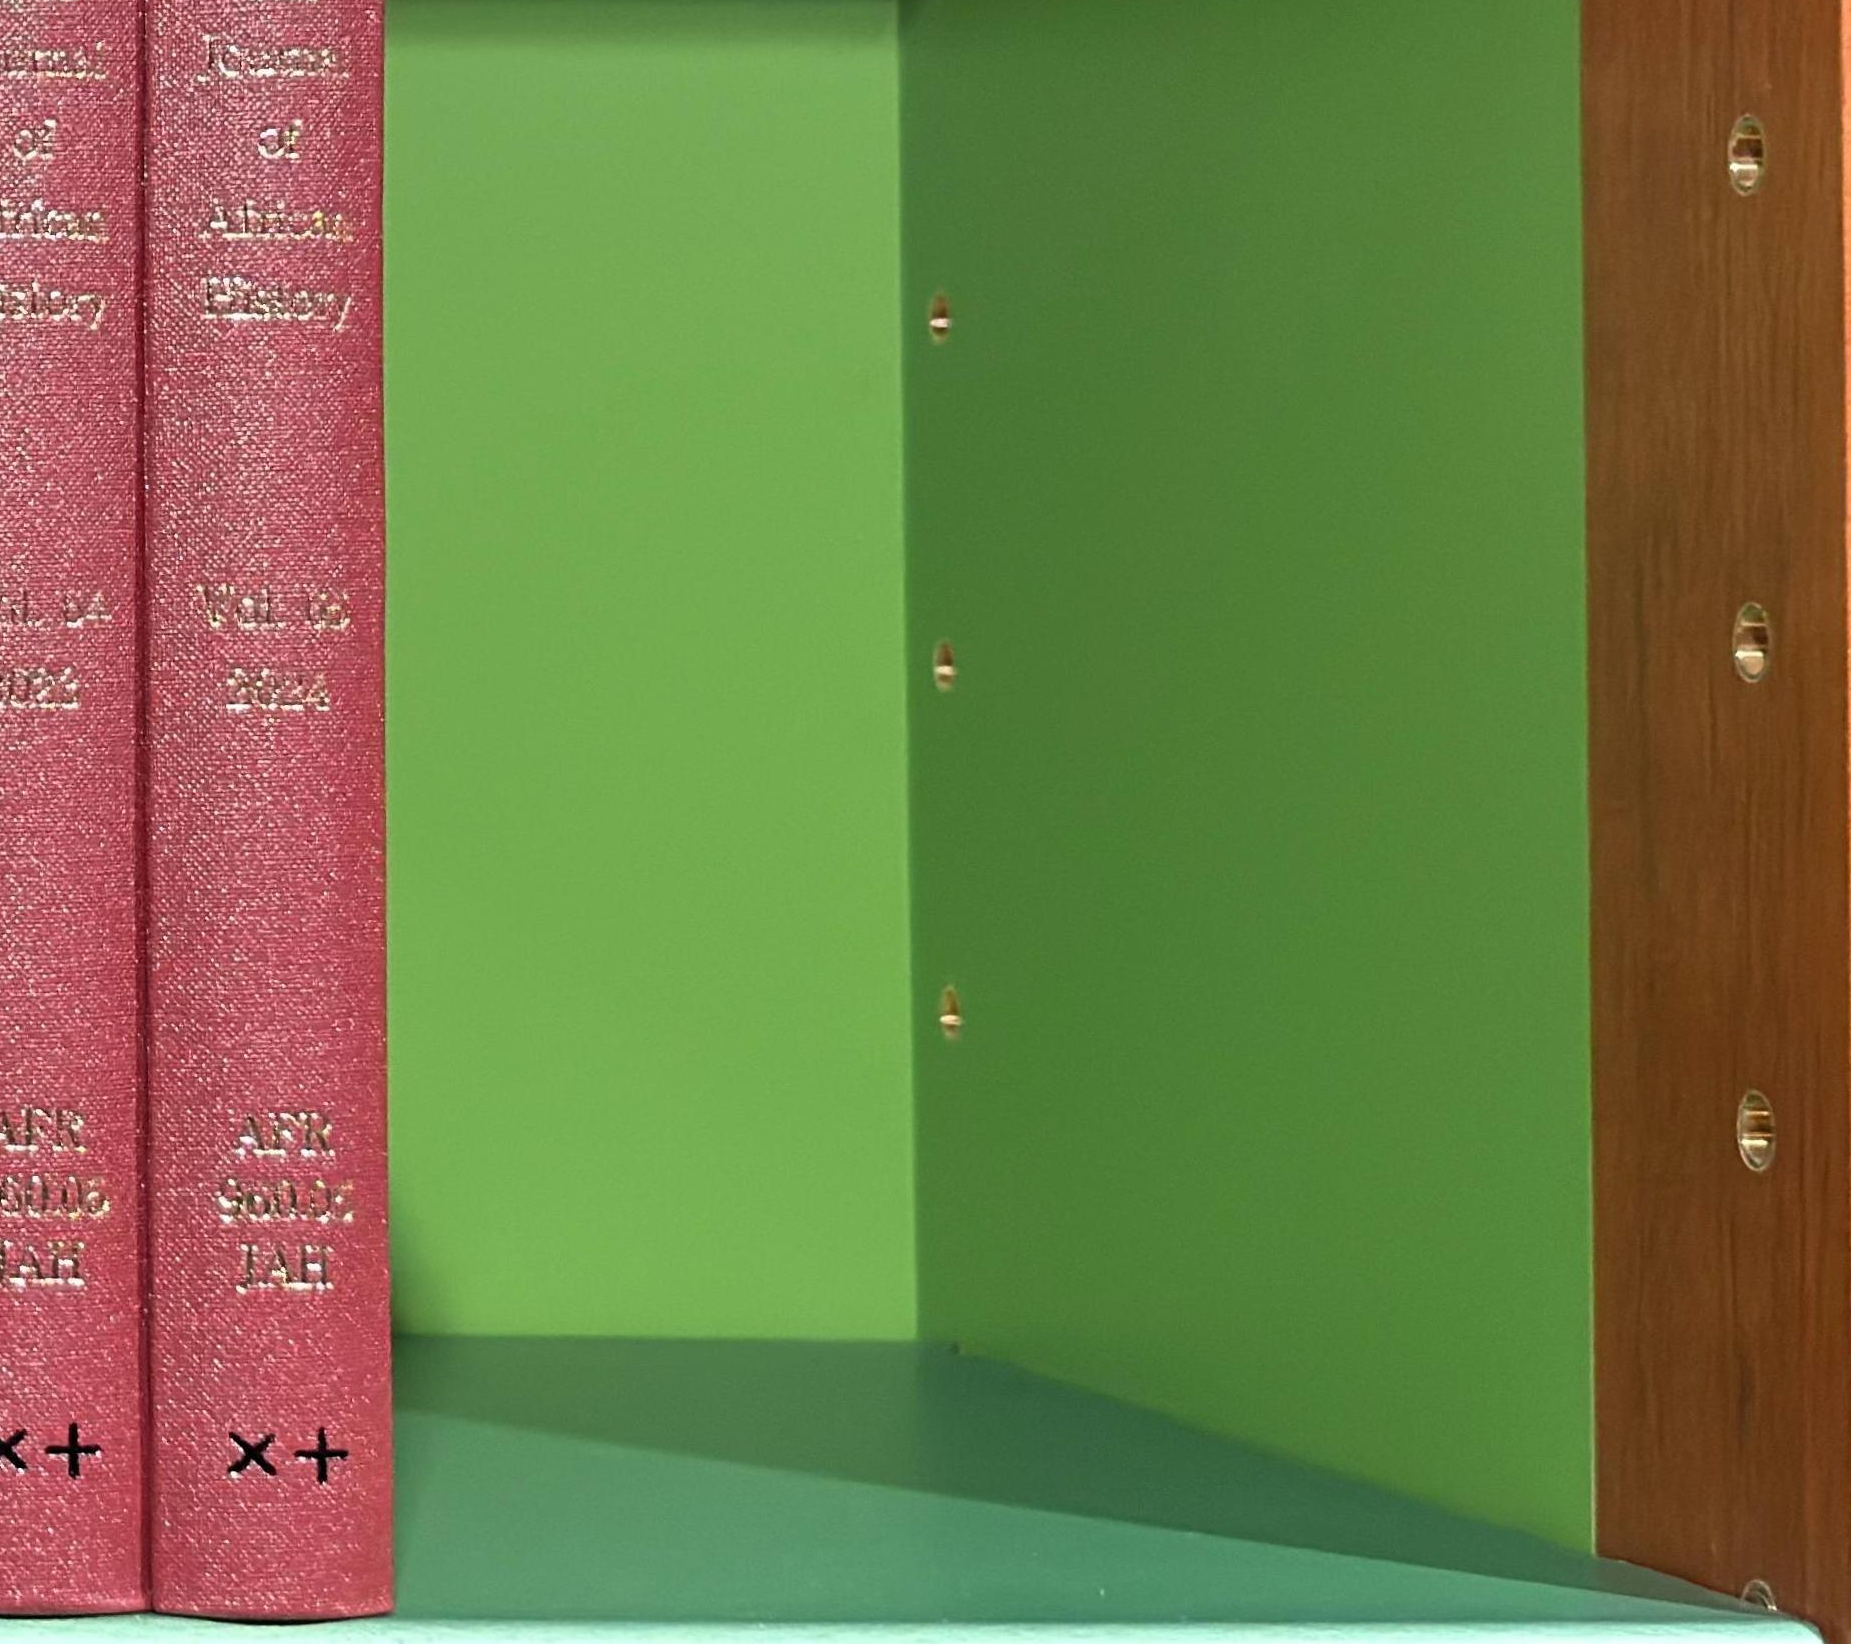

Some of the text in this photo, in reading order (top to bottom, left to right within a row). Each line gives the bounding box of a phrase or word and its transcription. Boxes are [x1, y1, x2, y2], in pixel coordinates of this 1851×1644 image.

[198, 36, 347, 82] Journal
[14, 120, 56, 159] of
[258, 120, 303, 159] of
[201, 200, 352, 241] African
[203, 276, 351, 330] History
[61, 591, 111, 629] 64
[227, 667, 329, 711] 2024
[230, 1110, 334, 1157] AFR
[217, 1178, 353, 1222] 960.05
[236, 1244, 332, 1293] JAH
